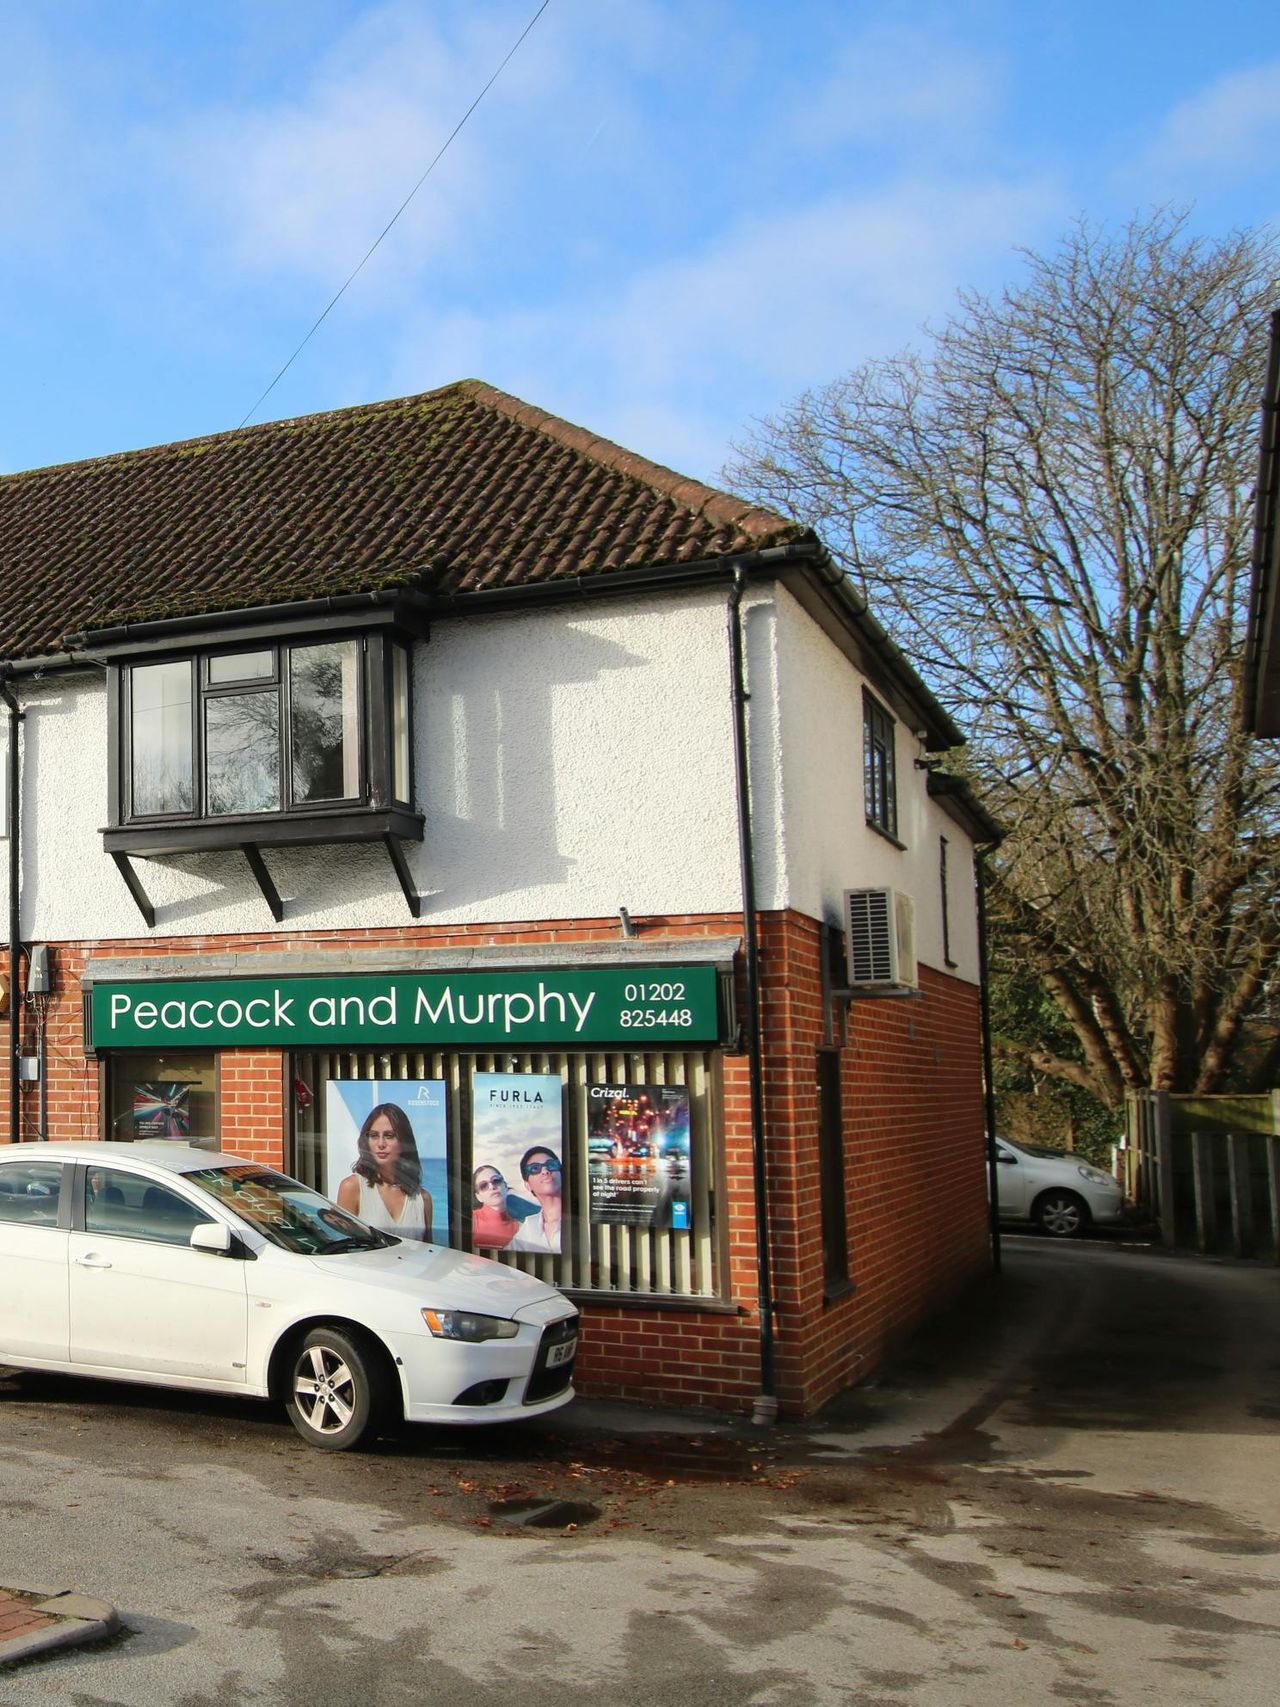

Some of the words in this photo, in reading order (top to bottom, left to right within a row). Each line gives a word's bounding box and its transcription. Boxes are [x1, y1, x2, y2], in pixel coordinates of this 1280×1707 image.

[624, 983, 686, 1001] 01202
[111, 989, 296, 1030] Peacock
[308, 986, 397, 1026] and
[414, 982, 596, 1033] Murphy
[619, 1009, 693, 1027] 825448
[490, 1090, 543, 1103] FURLA
[591, 1087, 630, 1098] Crizal.
